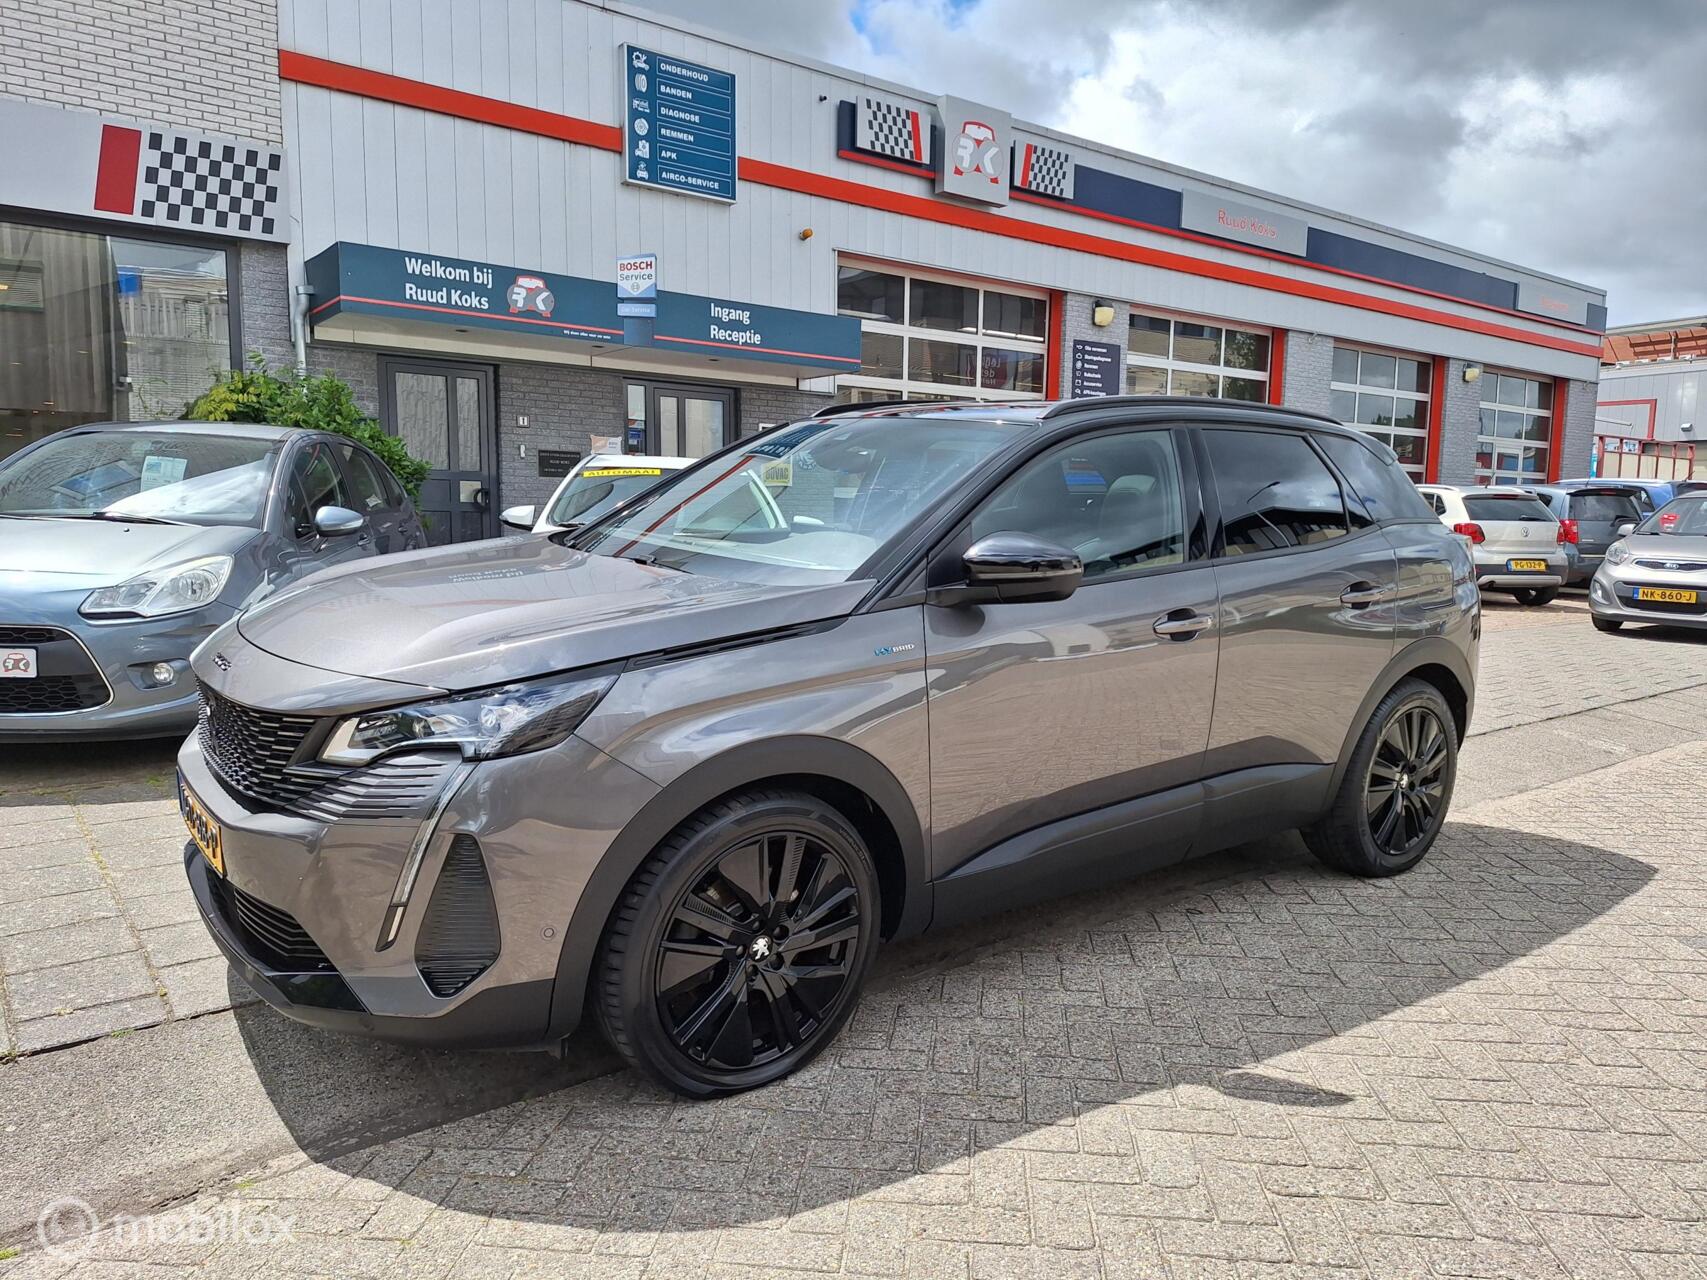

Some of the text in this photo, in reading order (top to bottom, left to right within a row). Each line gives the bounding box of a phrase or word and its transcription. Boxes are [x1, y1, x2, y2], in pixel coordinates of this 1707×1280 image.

[661, 63, 709, 82] ONDERHOUD
[661, 85, 692, 99] BANDEN
[661, 107, 700, 123] DIAGNOSE
[661, 128, 694, 142] REMMEN
[661, 150, 677, 160] APK
[662, 171, 719, 189] AIRCO-SERVICE
[405, 257, 492, 288] Welkom bij
[619, 261, 653, 271] BOSCH
[619, 273, 653, 281] Service
[405, 283, 489, 309] Ruud Koks
[711, 303, 750, 324] Ingang
[711, 325, 761, 345] Receptie
[1642, 589, 1692, 601] NK-860-J
